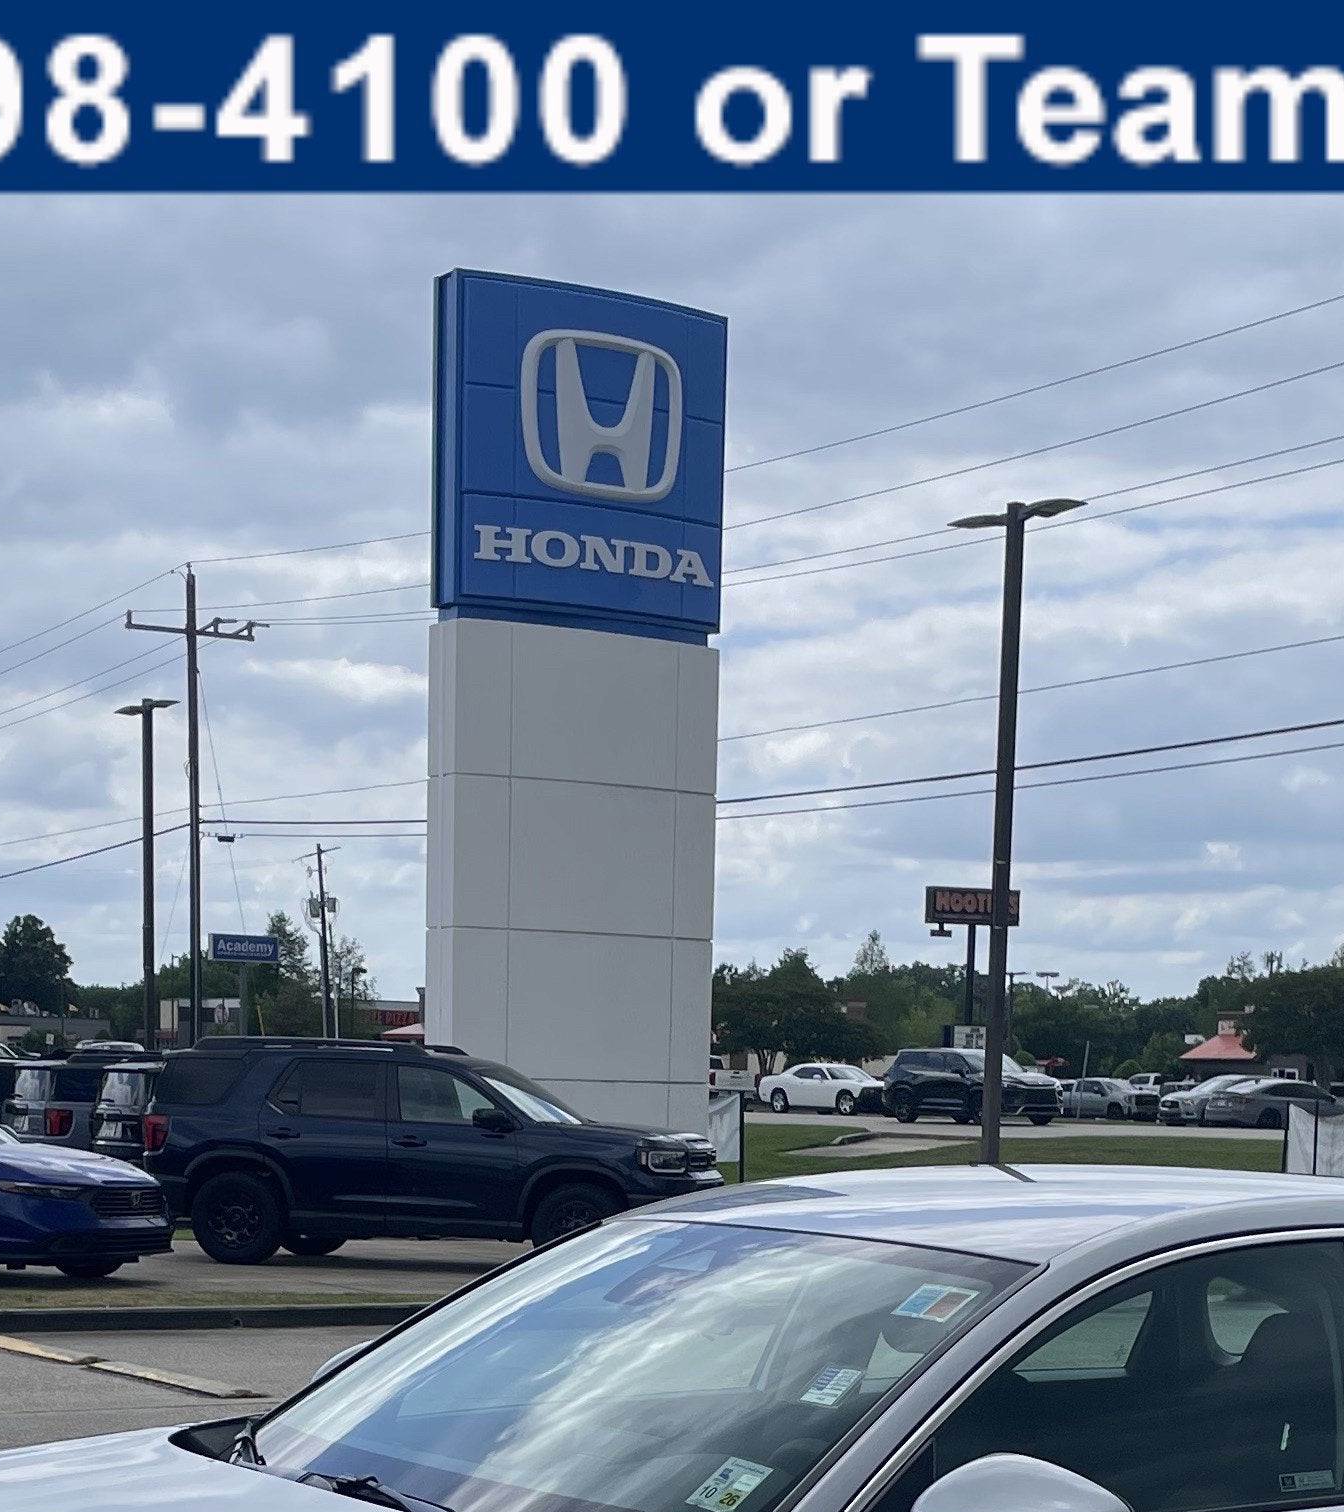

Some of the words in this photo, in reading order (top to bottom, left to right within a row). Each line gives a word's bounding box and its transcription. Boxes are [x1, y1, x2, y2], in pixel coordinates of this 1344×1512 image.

[474, 524, 714, 587] HONDA
[935, 891, 1018, 914] HOOTS
[218, 939, 274, 956] Academy
[699, 1485, 718, 1499] 10
[719, 1492, 741, 1506] 26
